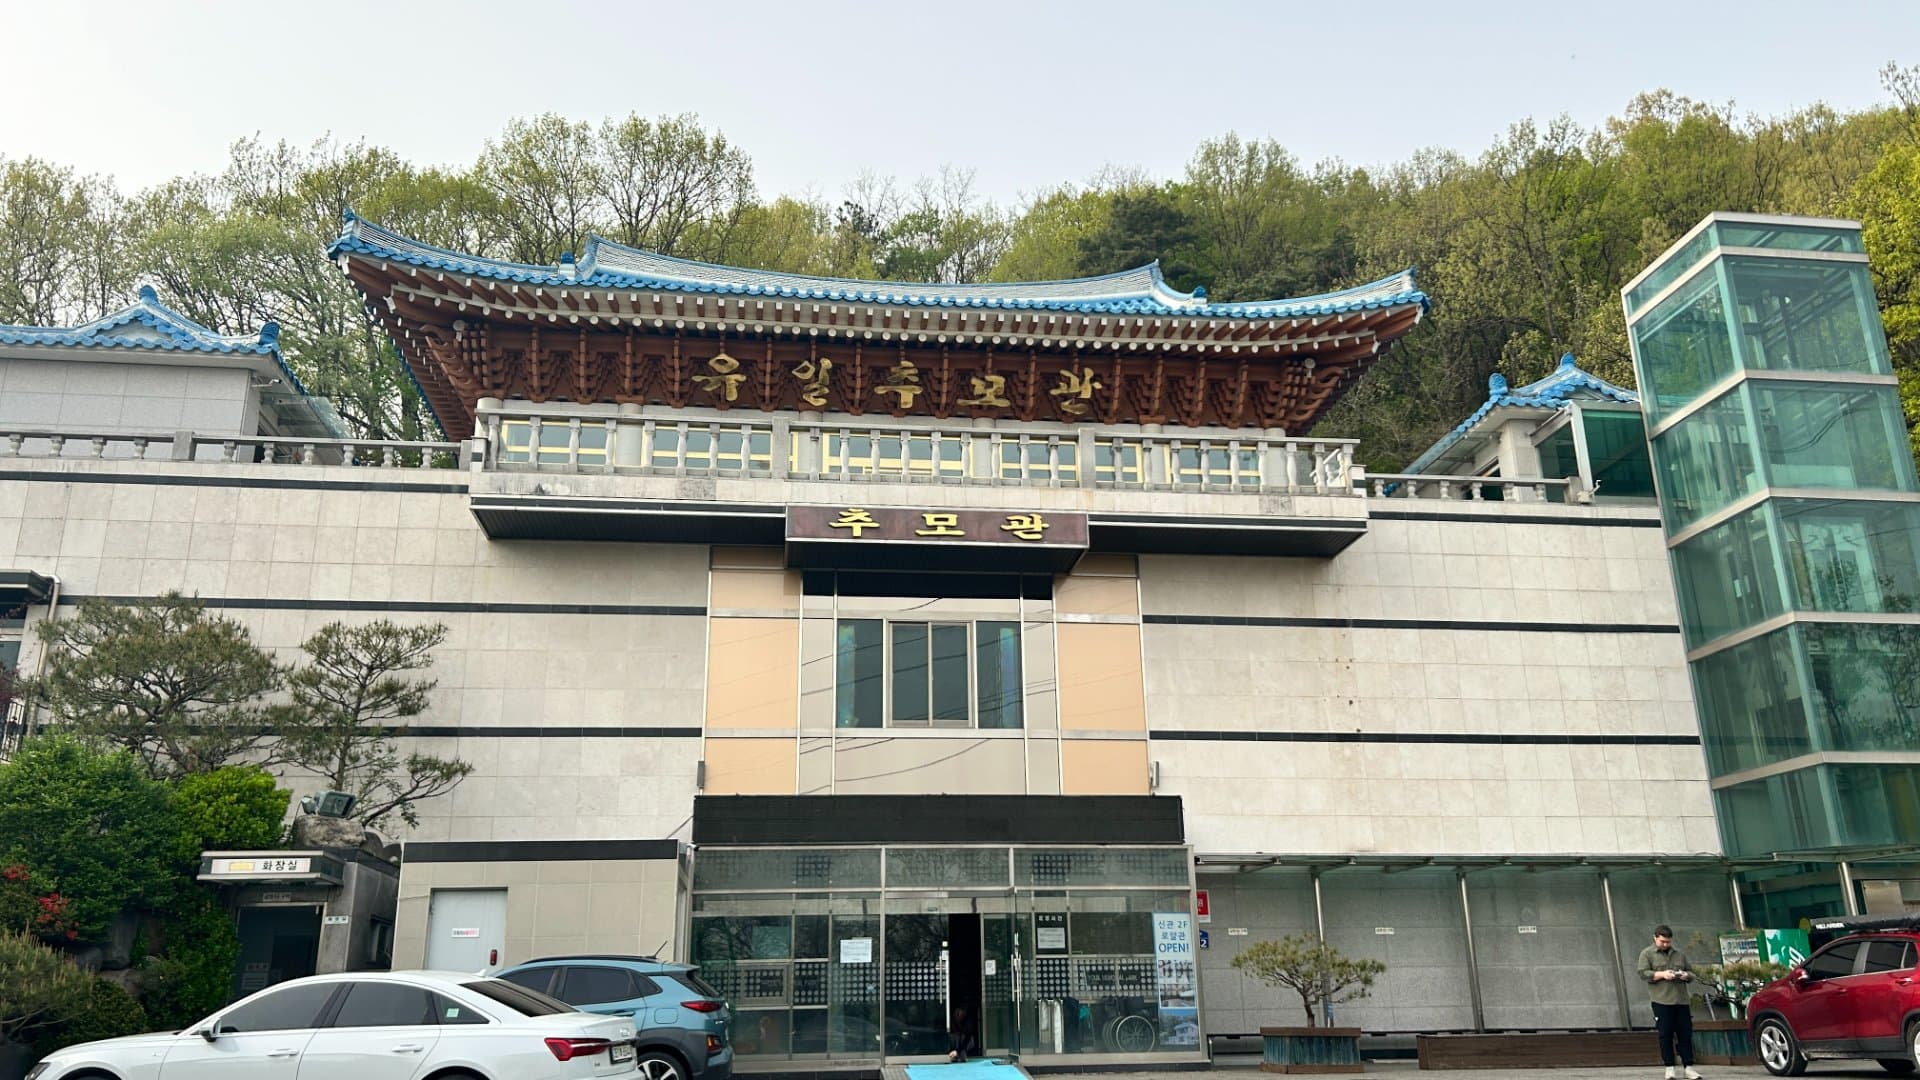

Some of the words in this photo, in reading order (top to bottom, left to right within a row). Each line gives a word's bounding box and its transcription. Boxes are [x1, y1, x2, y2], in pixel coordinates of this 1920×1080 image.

[691, 353, 1103, 414] 유일추모관
[829, 508, 1049, 539] 추모관
[262, 860, 298, 871] 화장실
[1177, 920, 1189, 929] 2F
[1158, 943, 1190, 953] OPEN!
